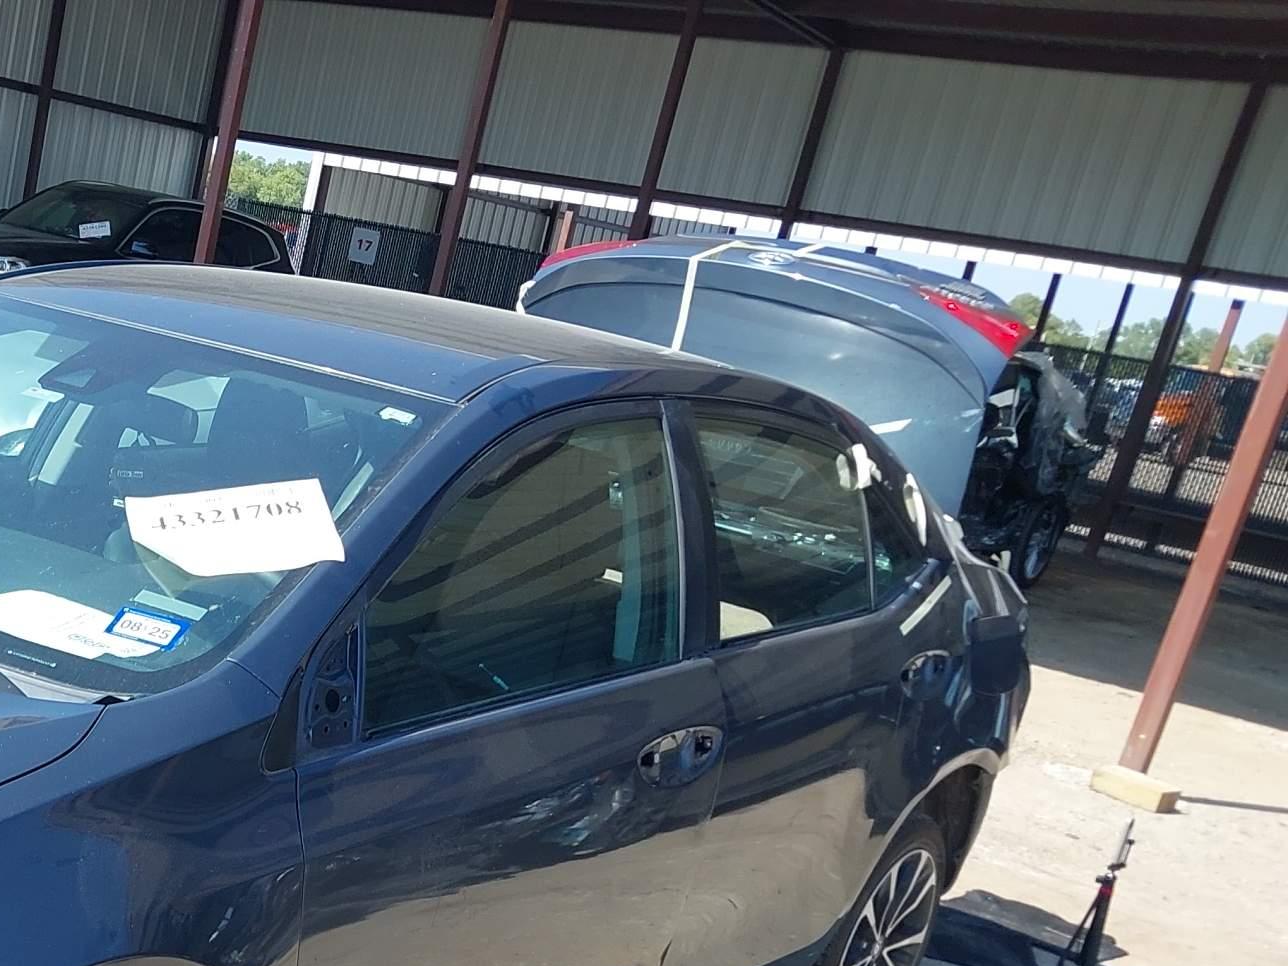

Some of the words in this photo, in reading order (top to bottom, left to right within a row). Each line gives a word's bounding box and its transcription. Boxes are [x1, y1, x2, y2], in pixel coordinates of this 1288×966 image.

[357, 239, 373, 251] 17
[152, 501, 302, 530] 43321708
[120, 619, 142, 632] 08
[148, 626, 172, 640] 25
